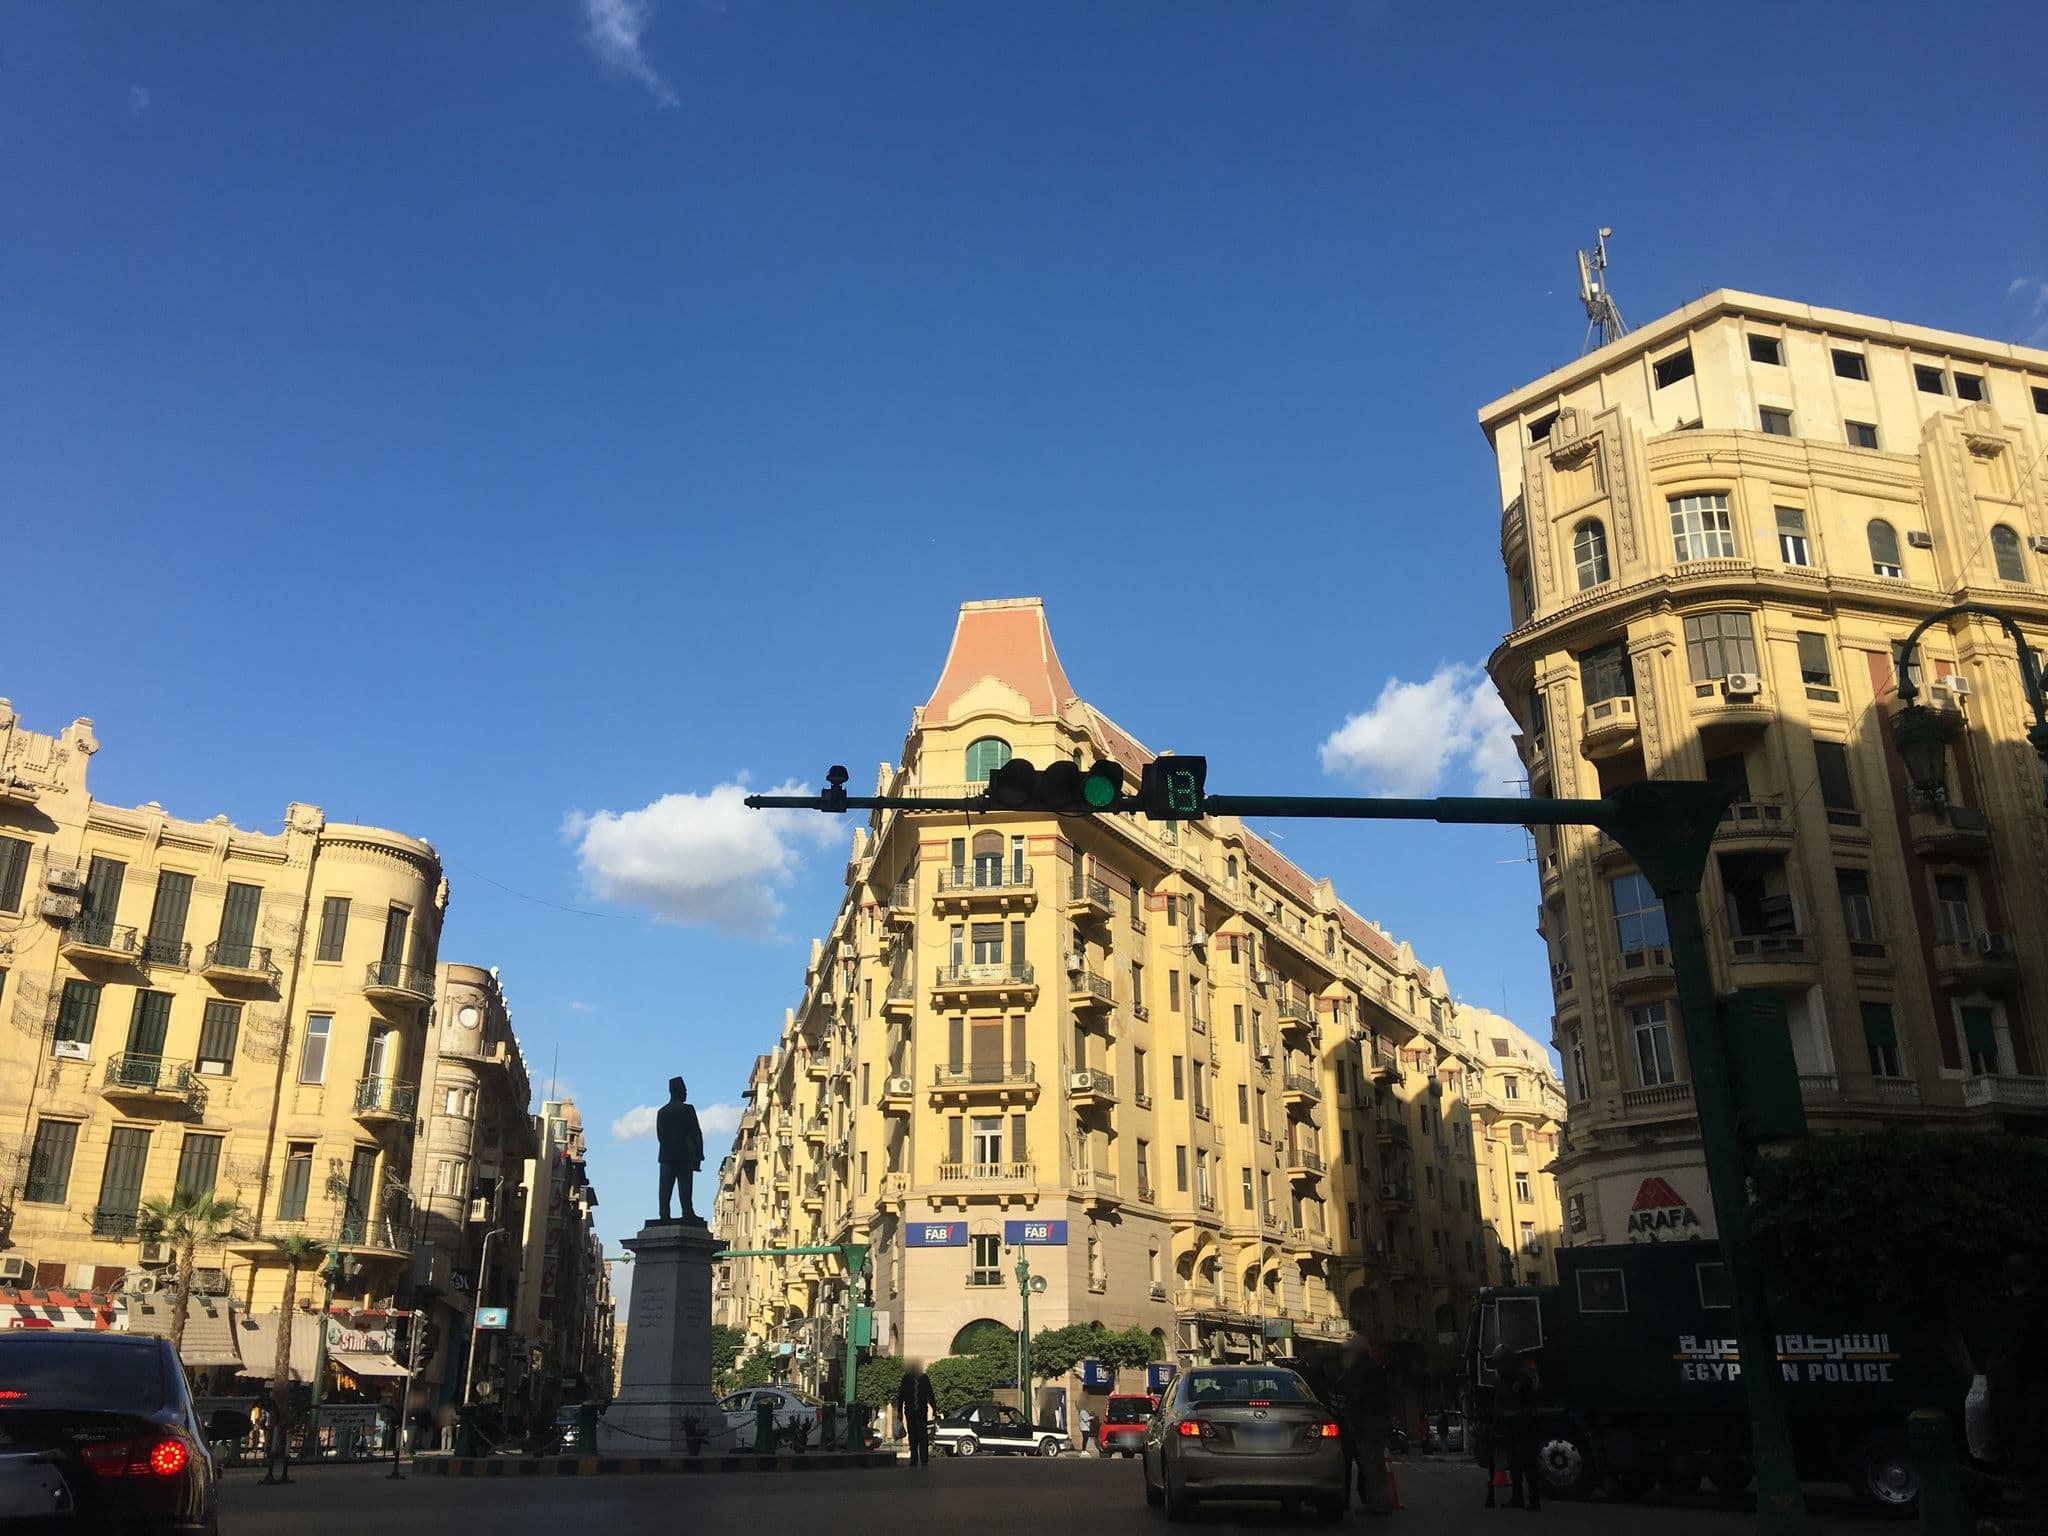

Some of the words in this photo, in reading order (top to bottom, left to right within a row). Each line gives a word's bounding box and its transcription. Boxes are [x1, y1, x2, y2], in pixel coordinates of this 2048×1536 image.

[1627, 1207, 1699, 1234] ARAFA
[925, 1229, 948, 1239] FAB
[1024, 1227, 1047, 1238] FAB
[1808, 1362, 1895, 1382] POLICE
